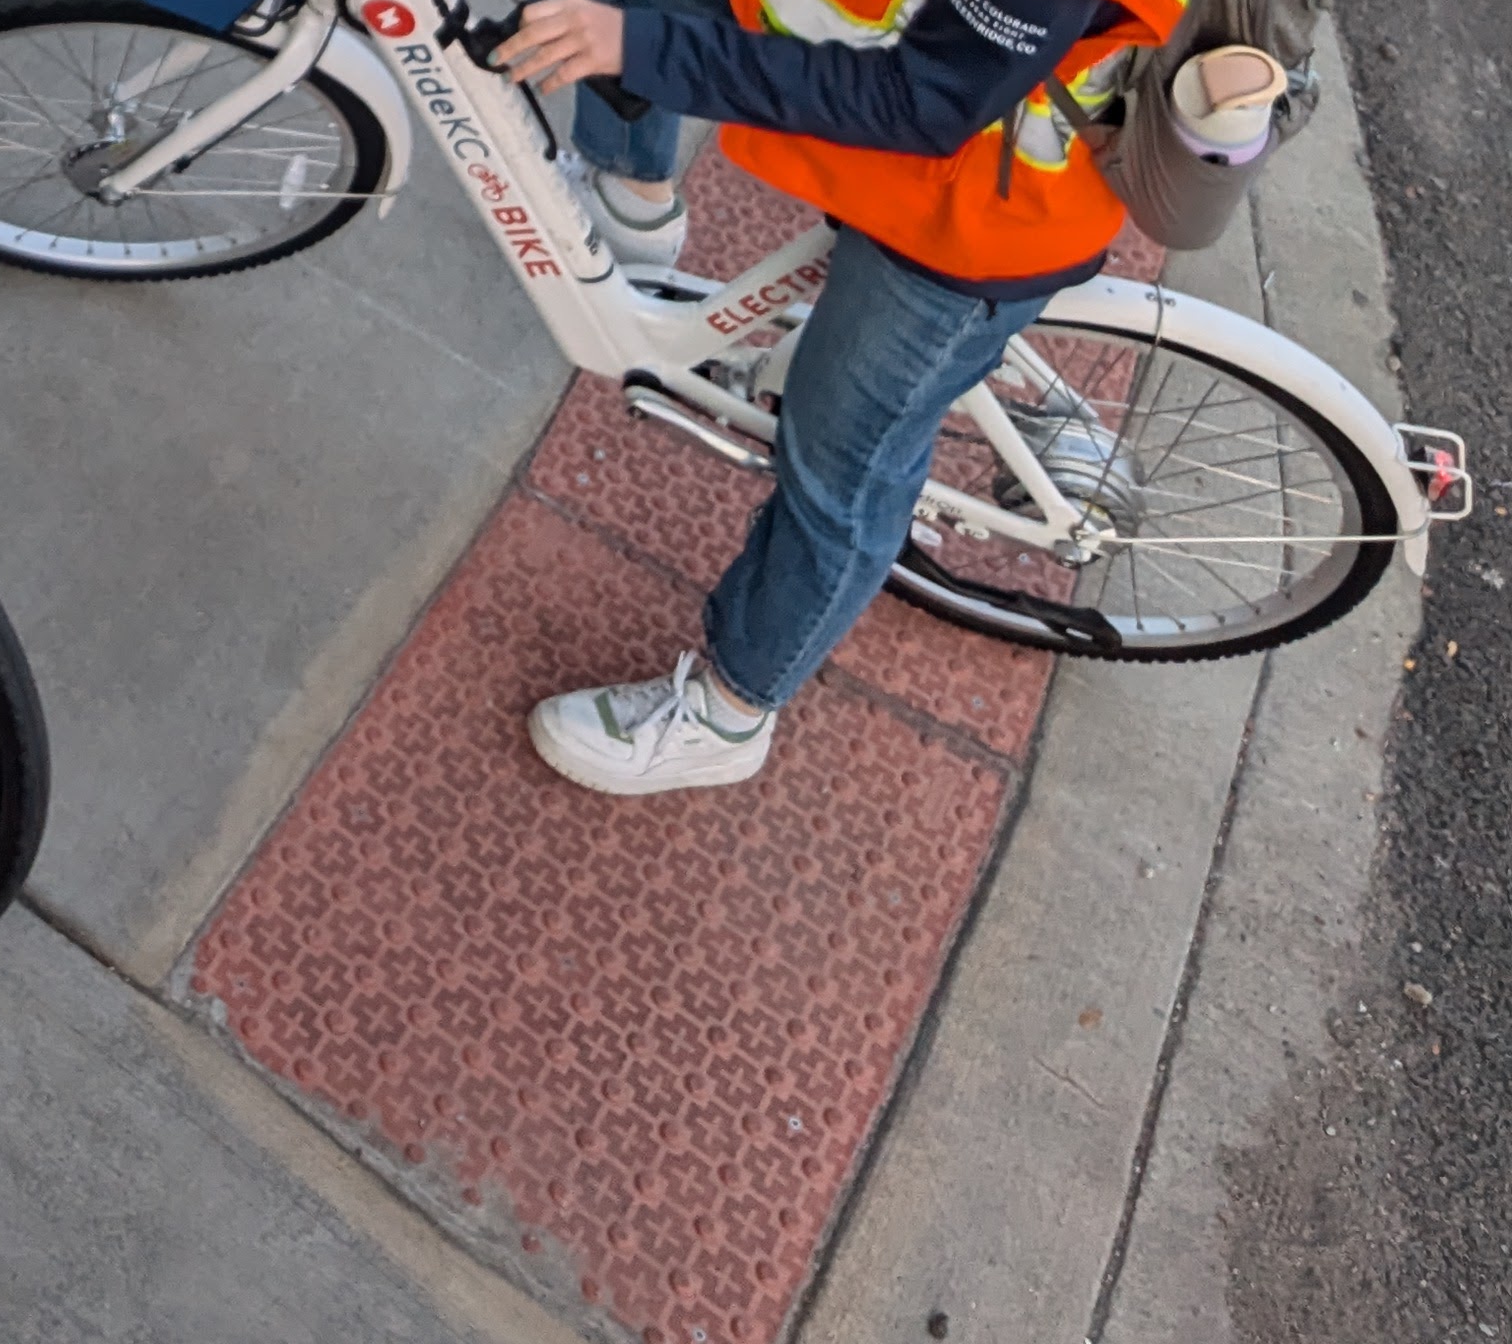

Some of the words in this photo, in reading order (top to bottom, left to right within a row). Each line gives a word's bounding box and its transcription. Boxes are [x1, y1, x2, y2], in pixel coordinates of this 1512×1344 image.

[983, 0, 1047, 37] COLORADO
[1016, 41, 1036, 54] CO
[395, 43, 490, 161] RideKC
[492, 205, 562, 279] BIKE
